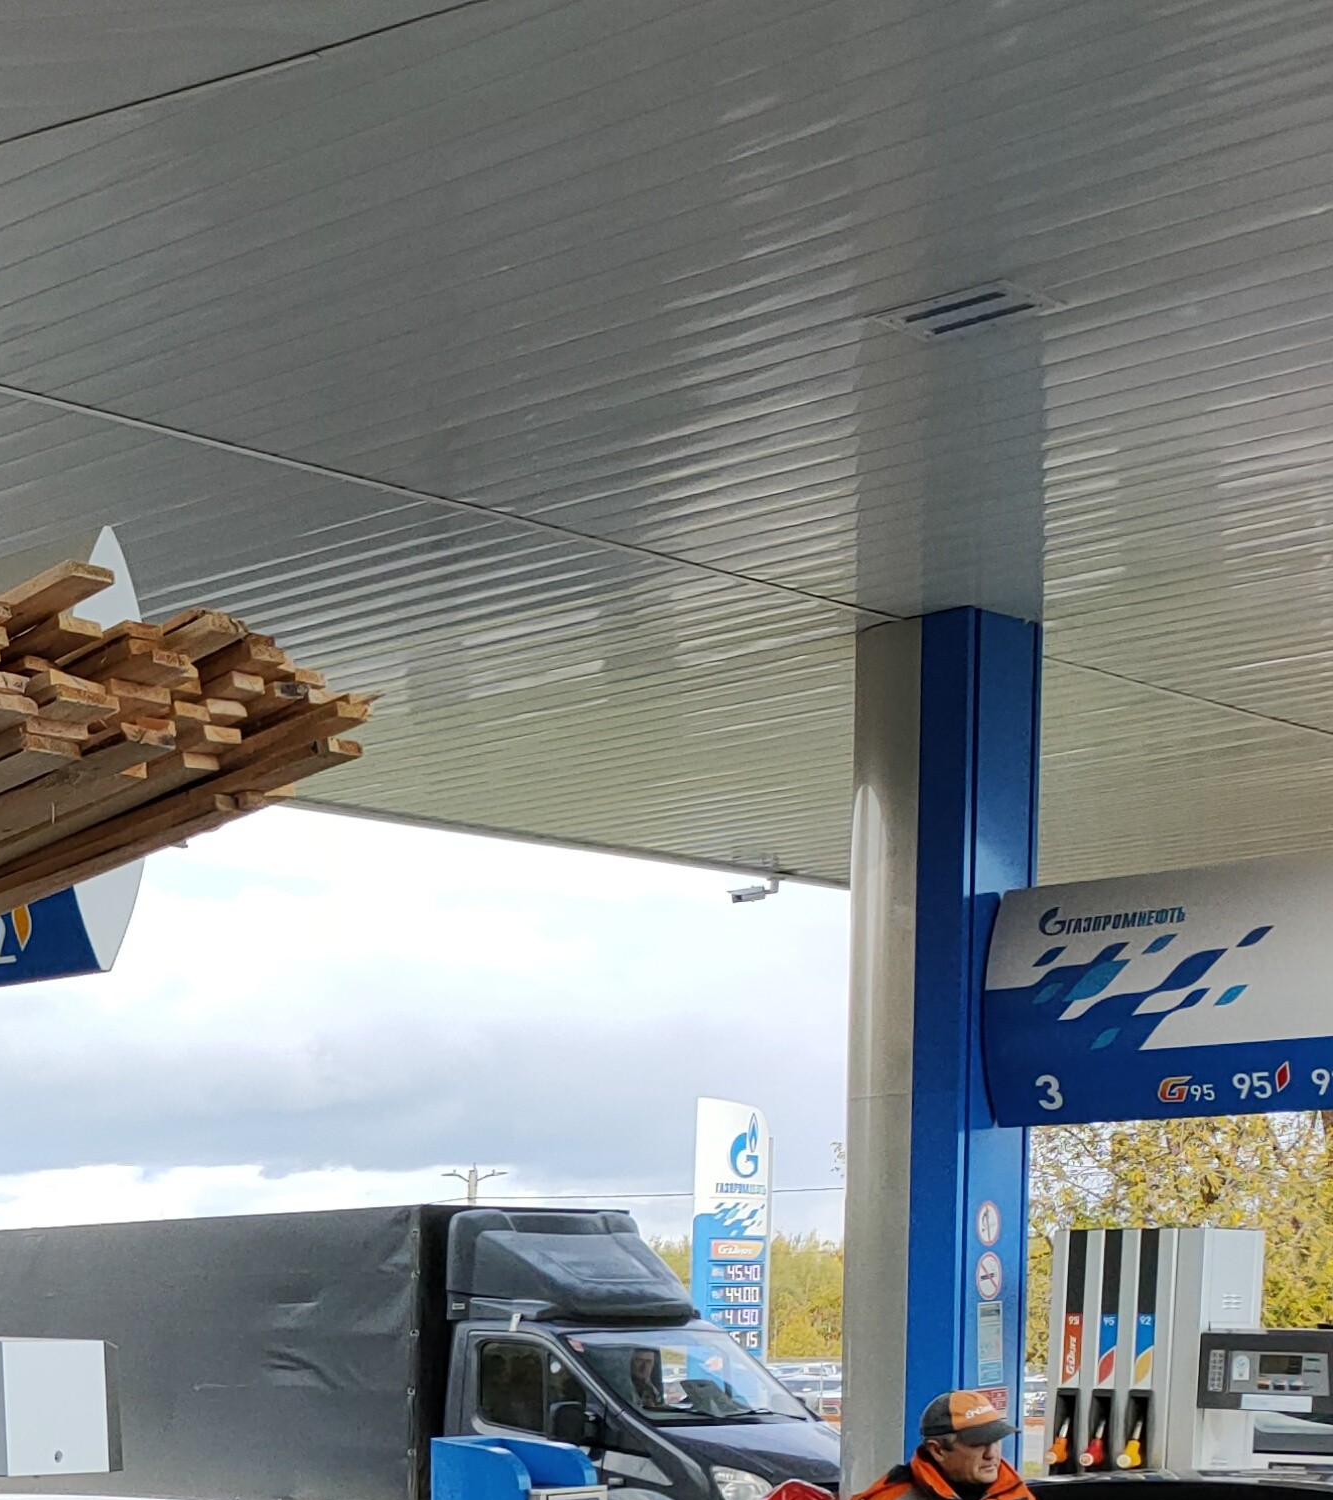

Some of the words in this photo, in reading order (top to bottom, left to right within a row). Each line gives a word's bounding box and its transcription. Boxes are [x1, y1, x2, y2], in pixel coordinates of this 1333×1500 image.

[1065, 906, 1186, 935] ГАЗПРОМНЕФТЬ
[1035, 1074, 1064, 1110] 3
[1232, 1071, 1273, 1099] 95
[1311, 1068, 1333, 1096] 9
